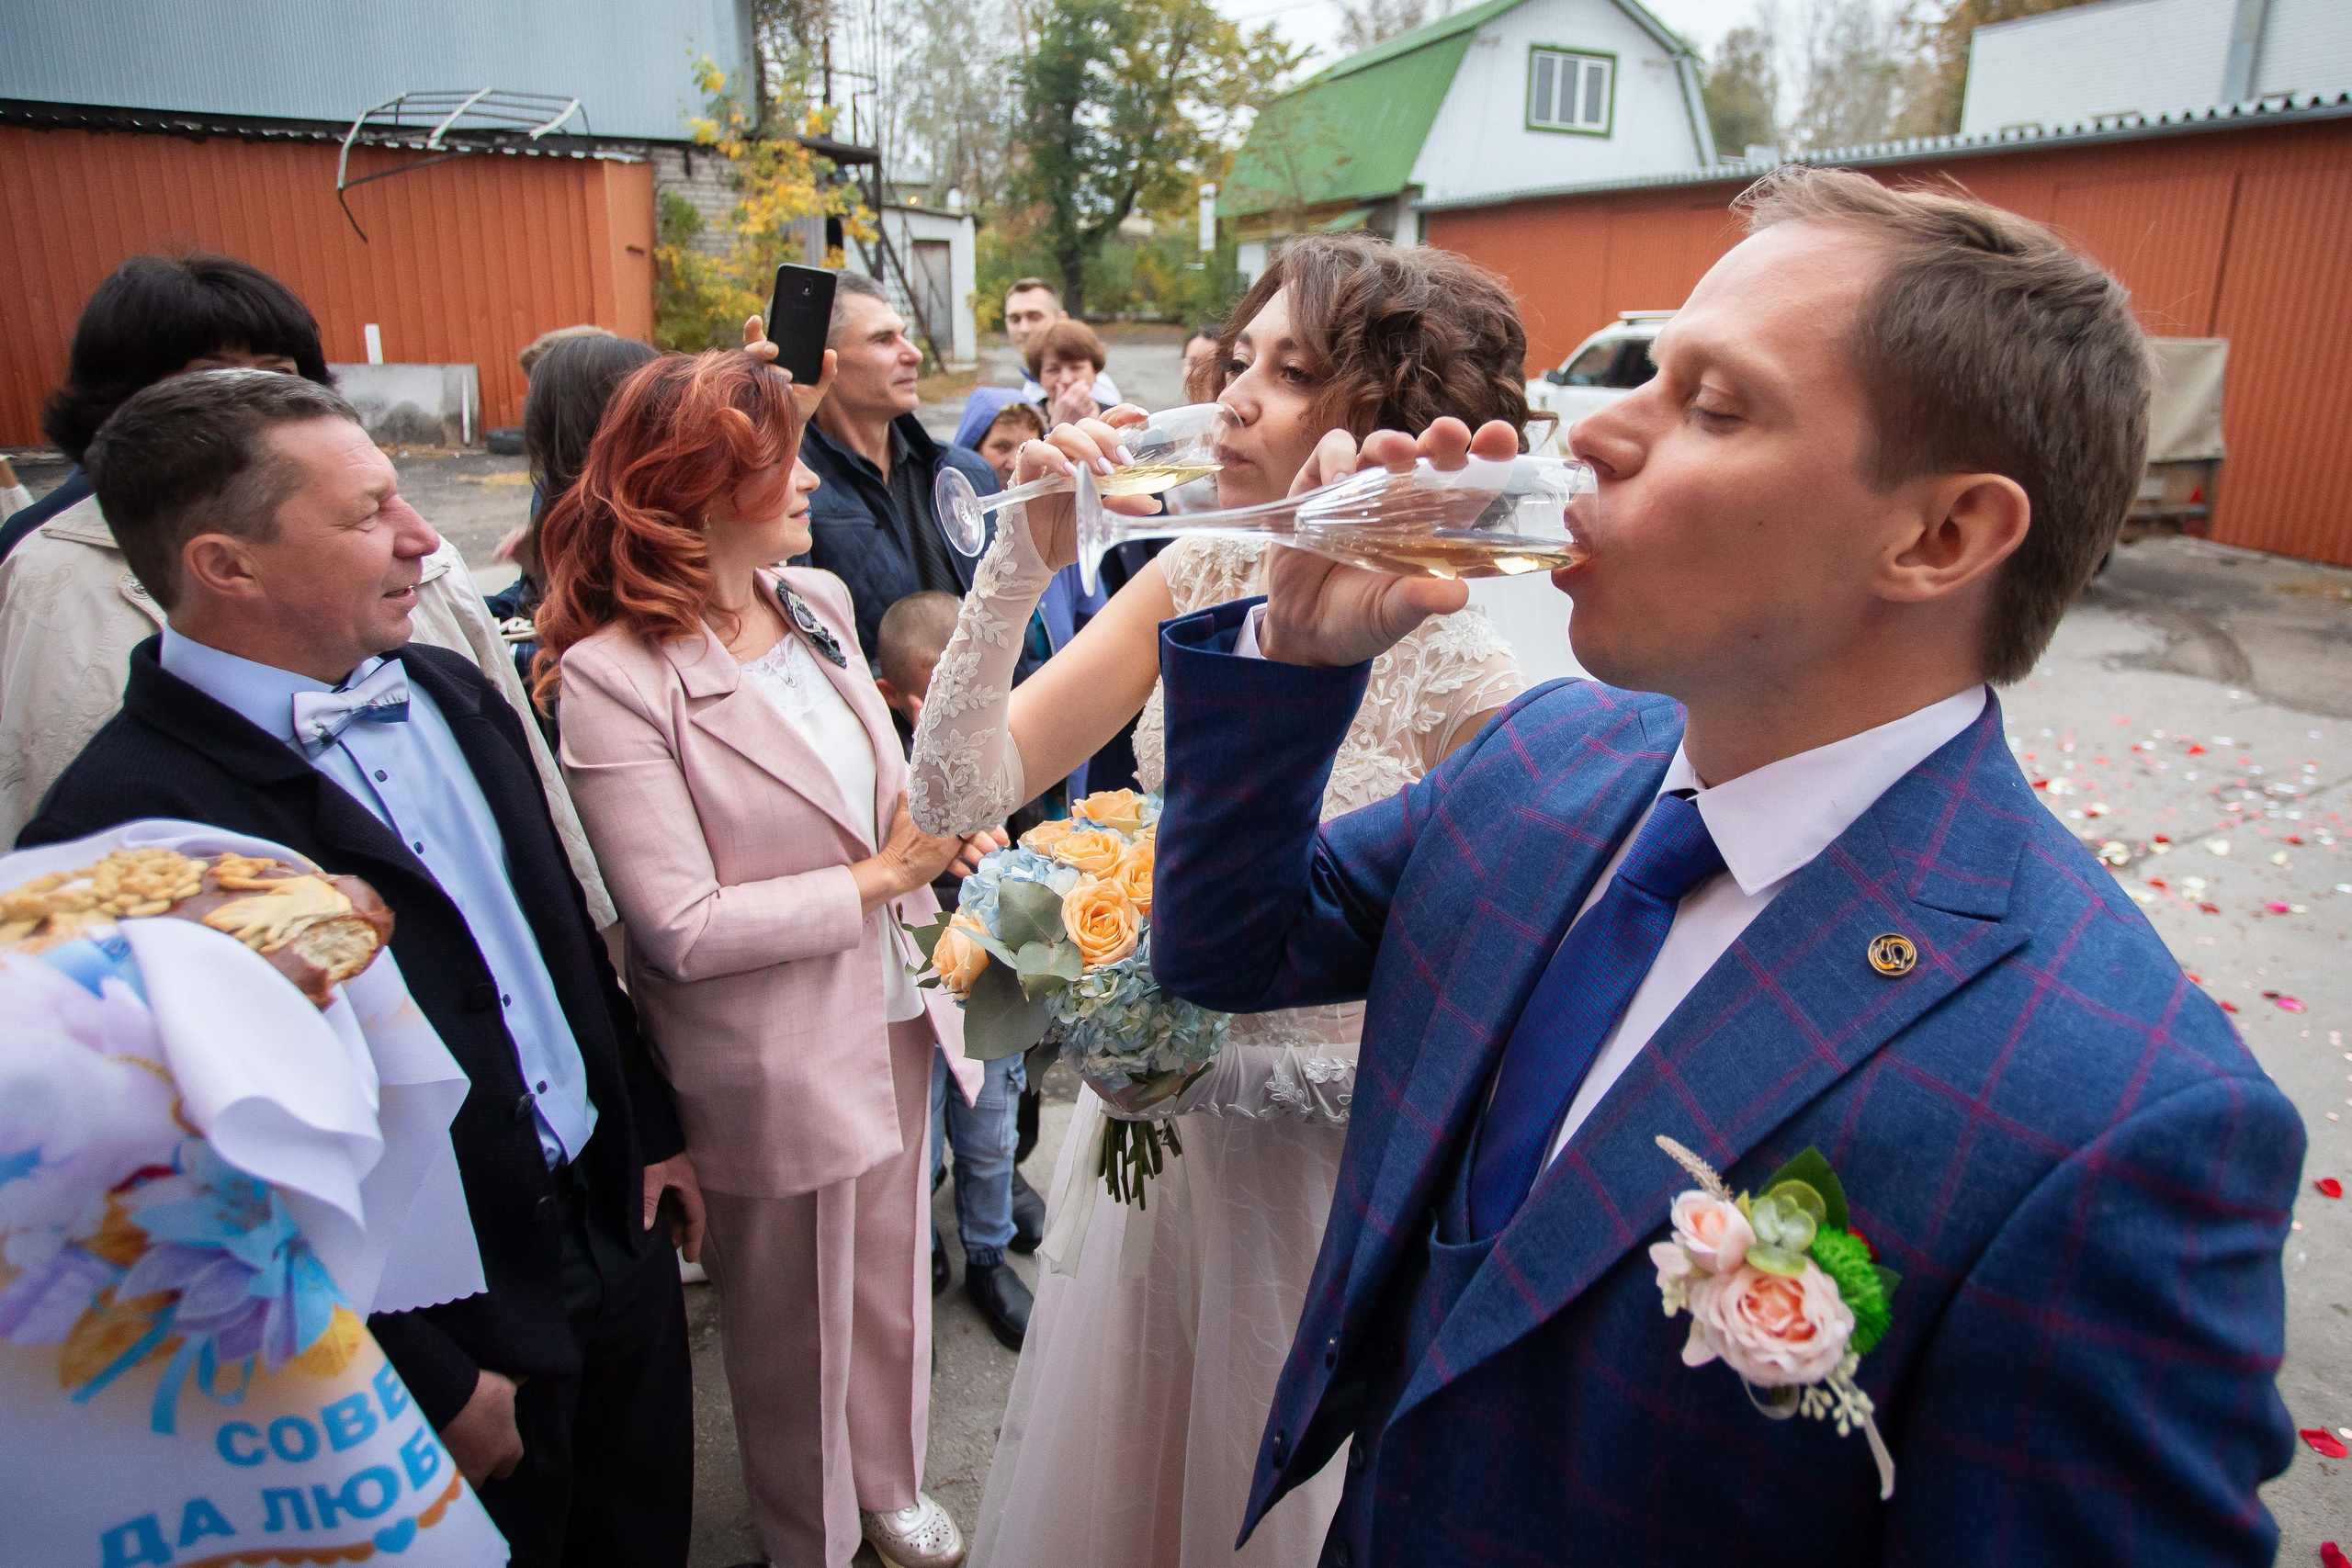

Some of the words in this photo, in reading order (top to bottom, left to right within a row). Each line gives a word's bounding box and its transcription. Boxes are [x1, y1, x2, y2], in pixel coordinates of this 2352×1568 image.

[215, 1360, 410, 1467] СОВЕ
[100, 1495, 236, 1568] ДА
[261, 1427, 440, 1532] ЛЮБ
